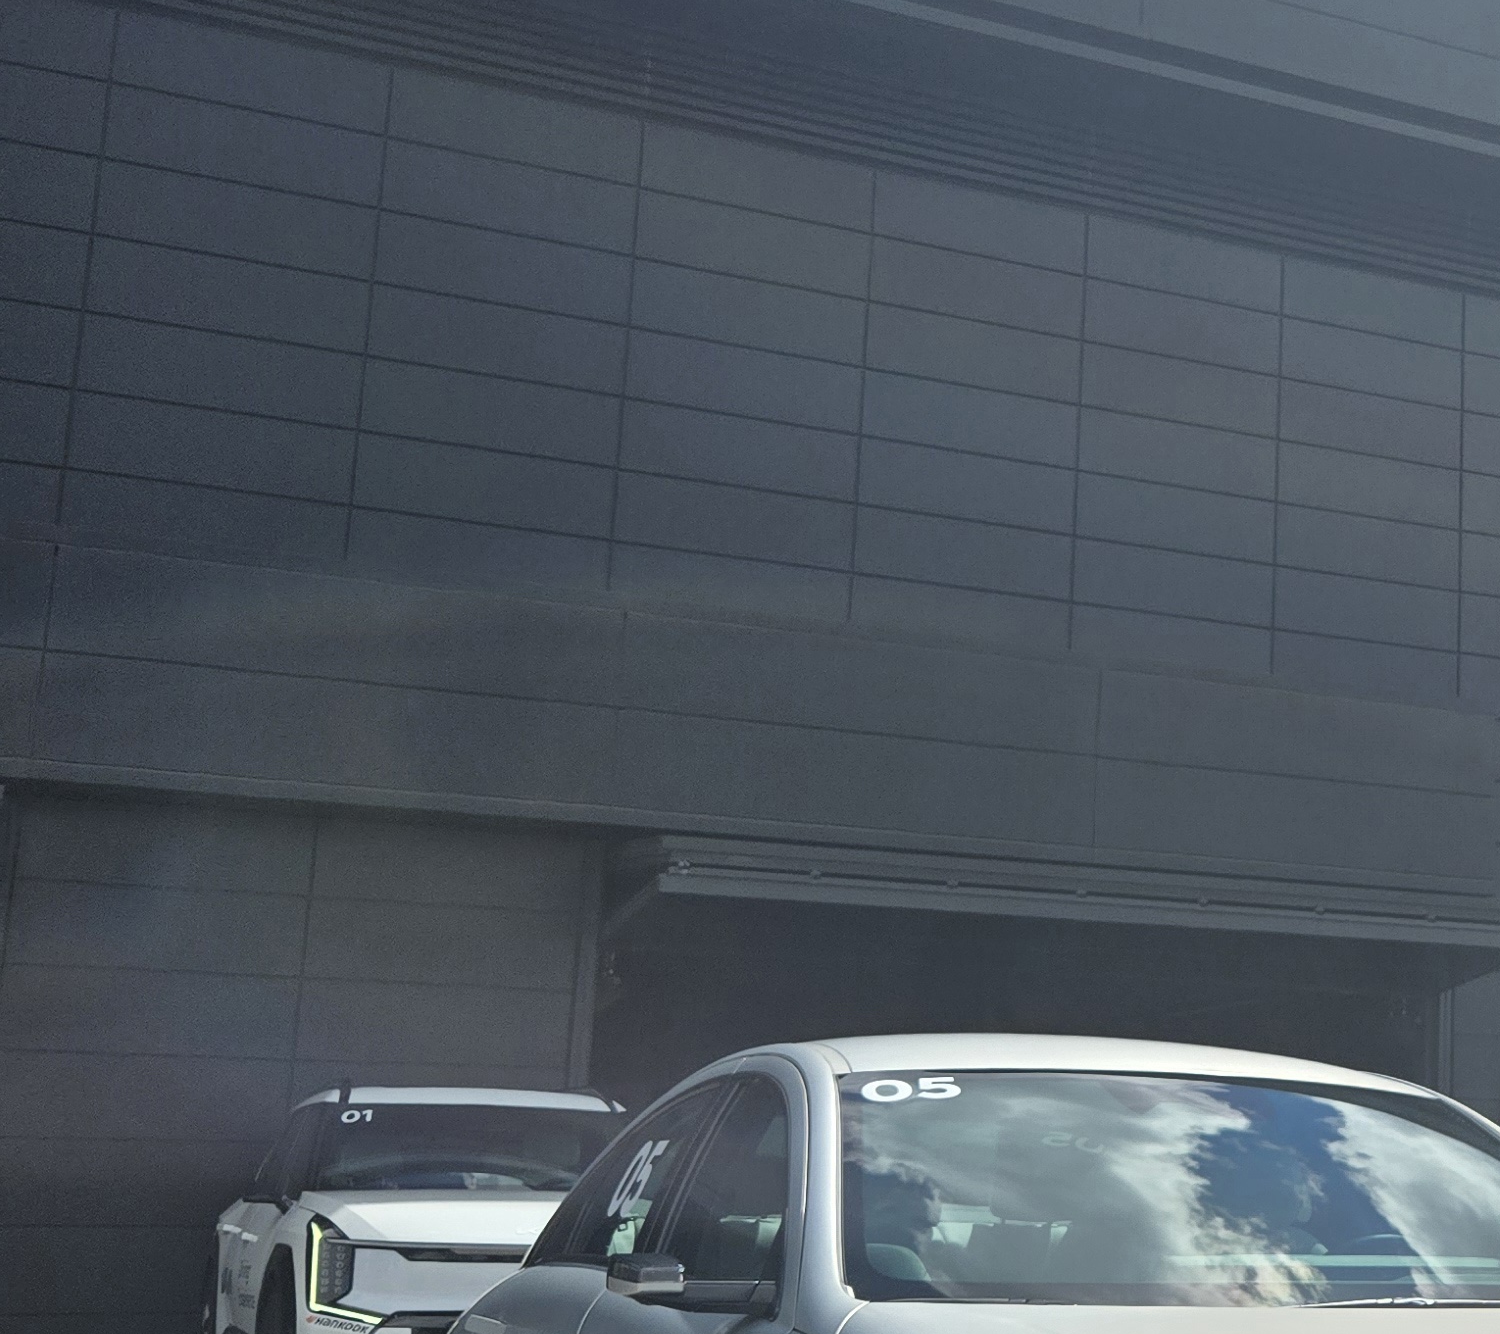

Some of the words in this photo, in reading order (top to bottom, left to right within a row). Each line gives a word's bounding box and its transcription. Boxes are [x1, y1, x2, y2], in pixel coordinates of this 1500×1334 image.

[861, 1077, 961, 1102] 05
[341, 1109, 373, 1124] 01
[607, 1140, 670, 1218] 05
